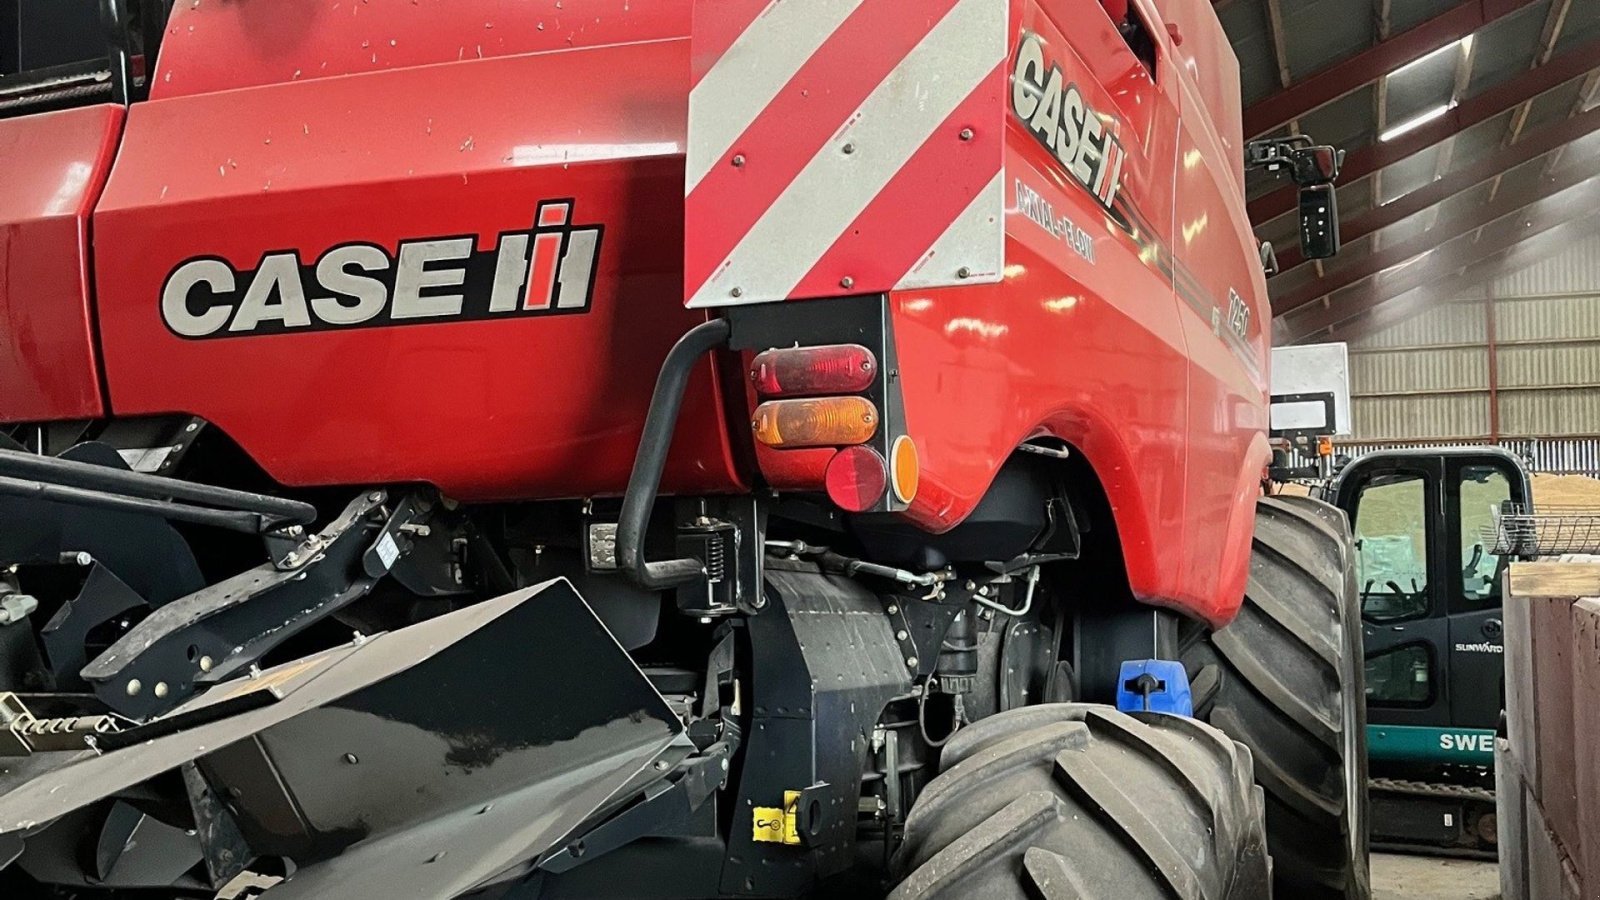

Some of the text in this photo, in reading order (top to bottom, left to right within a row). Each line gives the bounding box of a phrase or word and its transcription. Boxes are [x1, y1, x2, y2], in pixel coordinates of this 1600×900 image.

[1013, 36, 1102, 186] CASE
[161, 237, 474, 337] CASE
[1440, 734, 1494, 752] SWE
